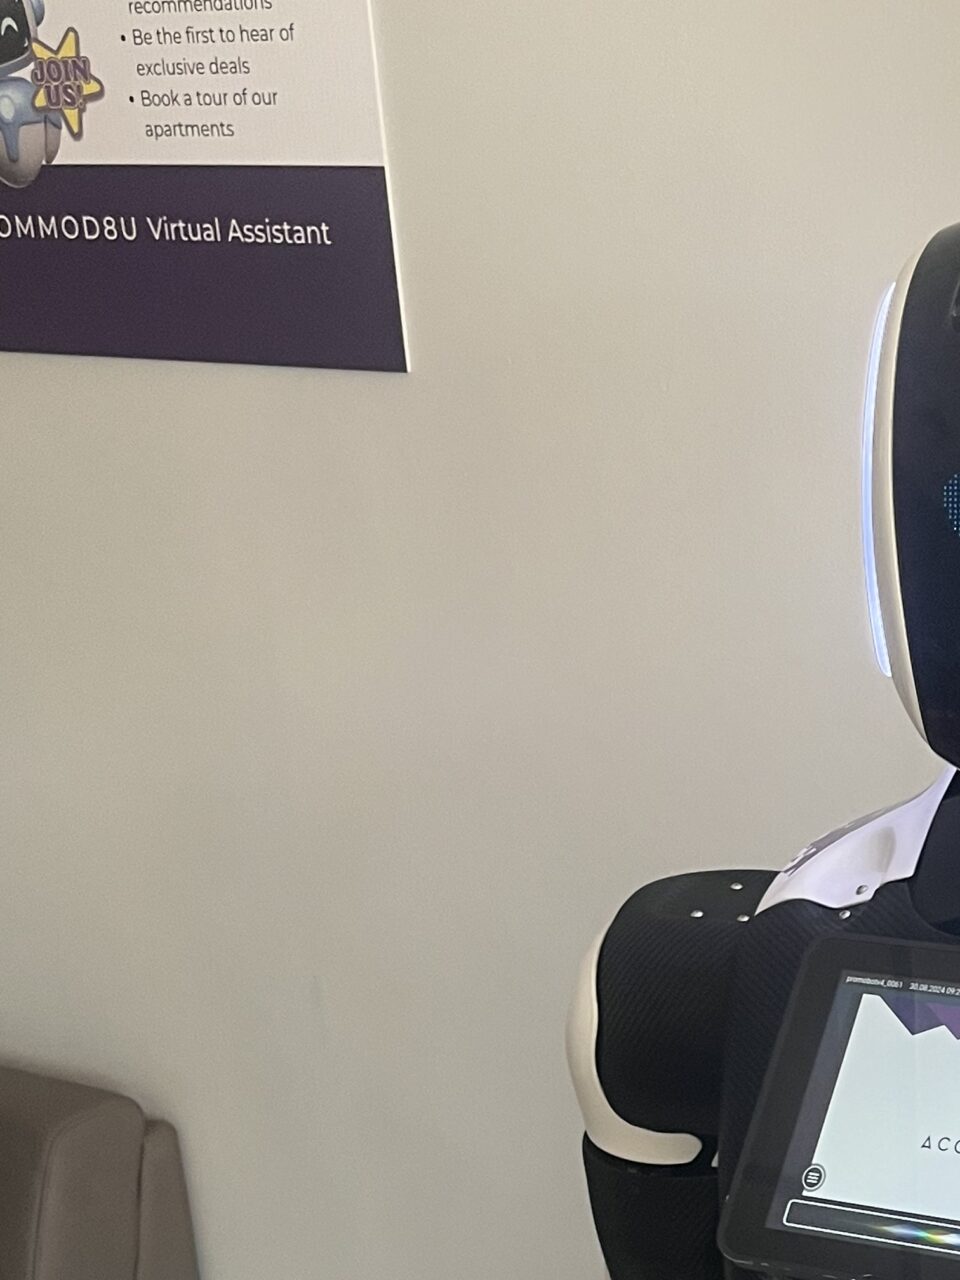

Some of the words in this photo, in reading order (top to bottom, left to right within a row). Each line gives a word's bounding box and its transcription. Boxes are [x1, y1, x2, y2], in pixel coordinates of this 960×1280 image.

[128, 0, 273, 14] recommendations
[132, 28, 153, 46] Be
[156, 26, 182, 45] the
[185, 25, 216, 44] first
[219, 28, 236, 43] to
[239, 24, 275, 43] hear
[279, 22, 295, 42] of
[32, 57, 90, 84] JOIN
[136, 57, 205, 77] exclusive
[209, 56, 250, 75] deals
[44, 82, 86, 109] US!
[140, 89, 181, 107] Book
[185, 94, 193, 106] a
[196, 90, 228, 106] tour
[233, 88, 248, 106] of
[251, 90, 278, 106] our
[145, 121, 235, 141] apartments
[147, 216, 222, 242] Virtual
[228, 217, 332, 245] Assistant
